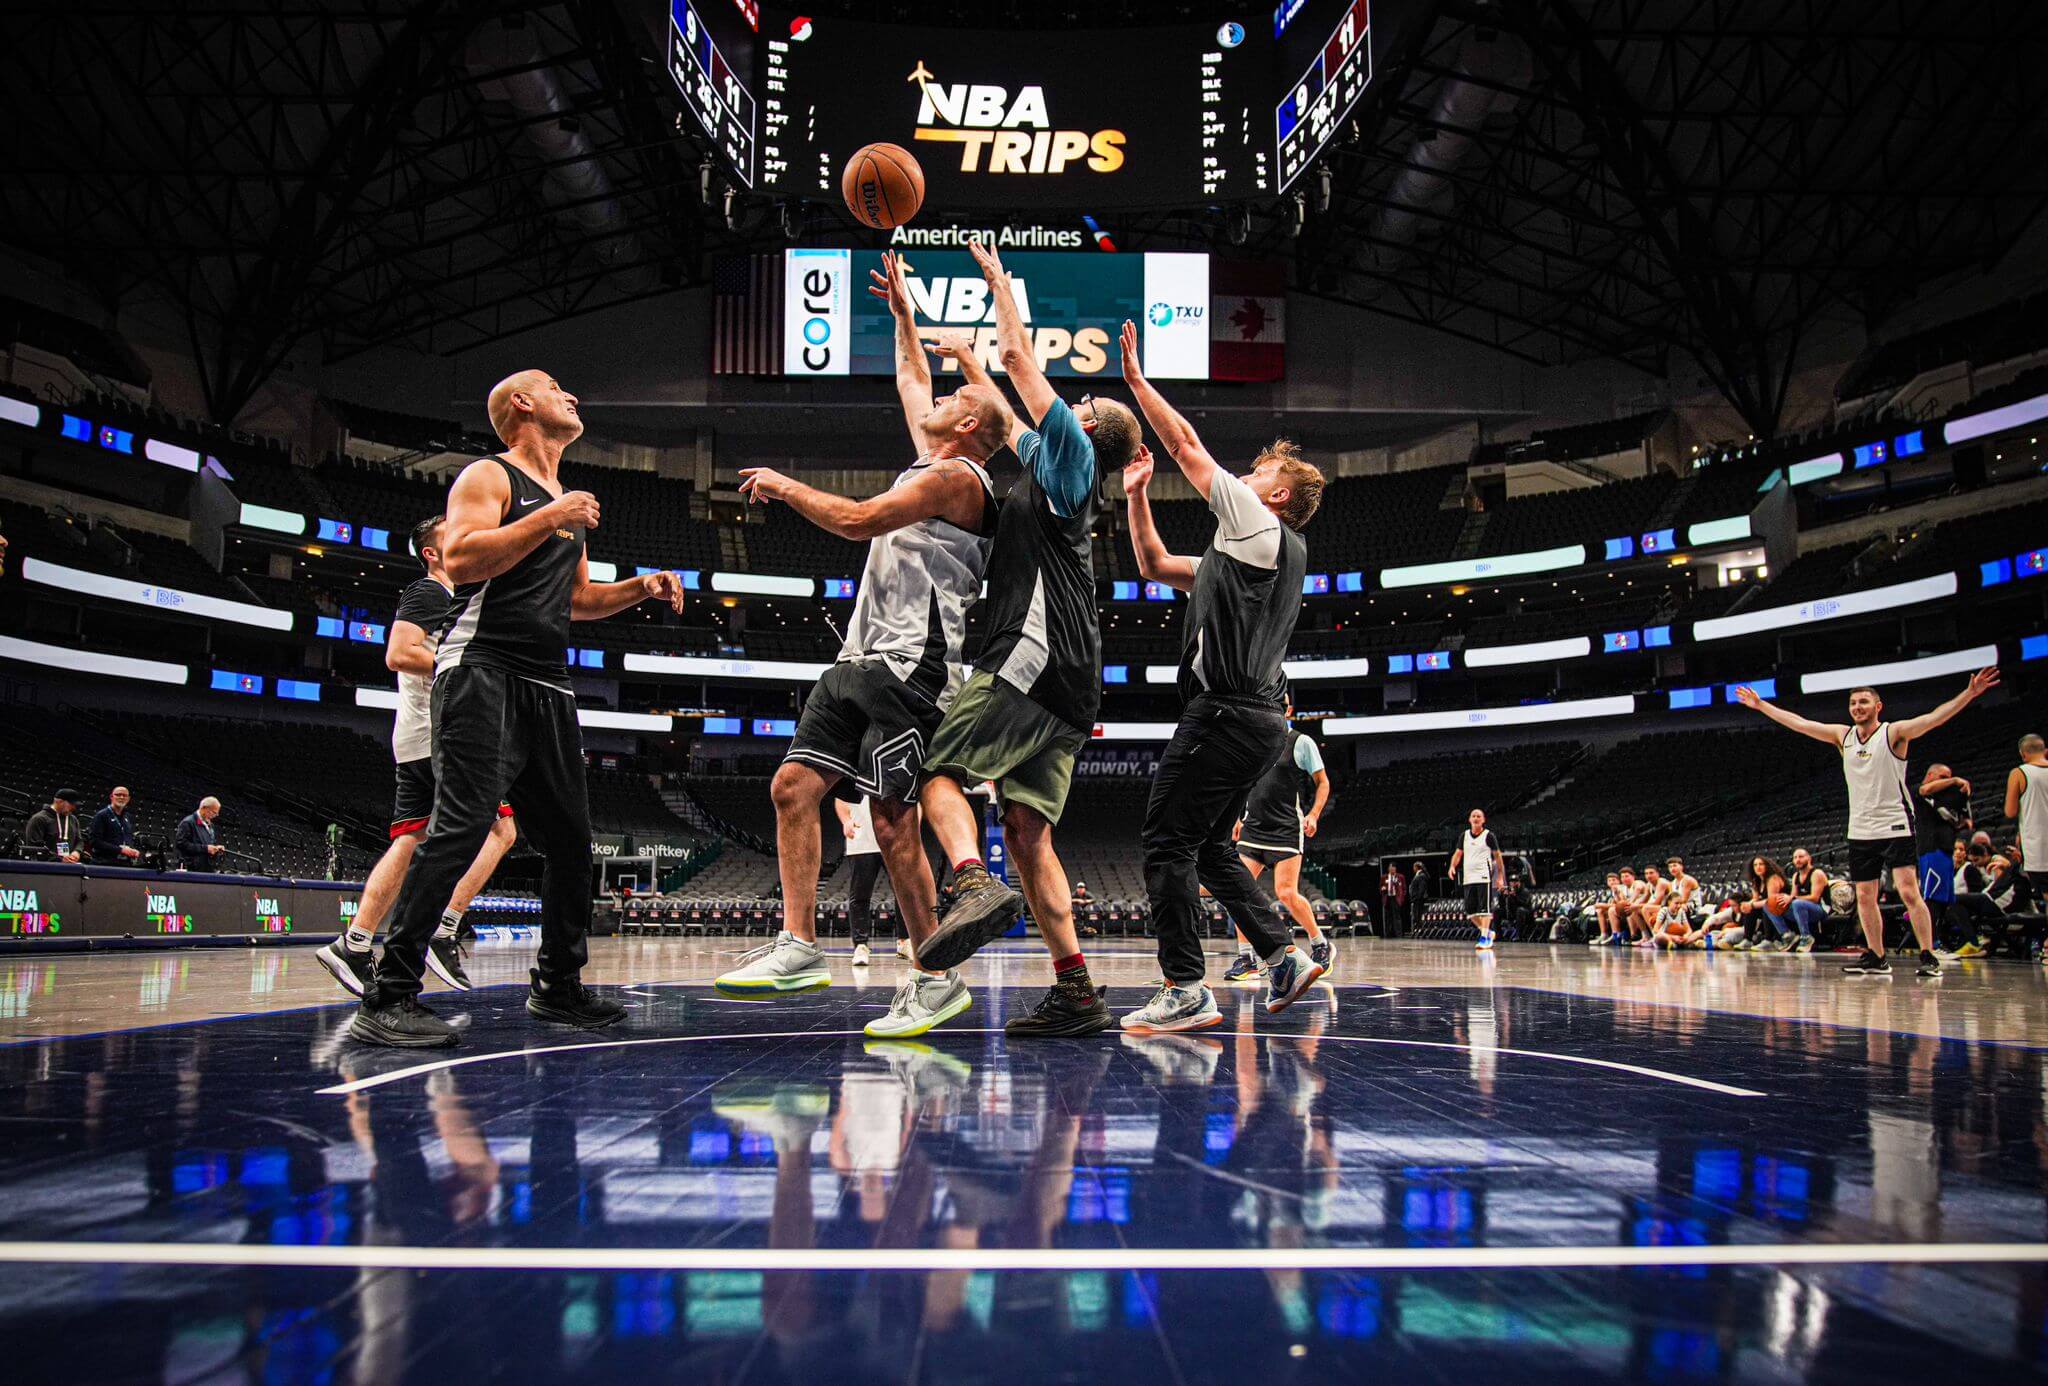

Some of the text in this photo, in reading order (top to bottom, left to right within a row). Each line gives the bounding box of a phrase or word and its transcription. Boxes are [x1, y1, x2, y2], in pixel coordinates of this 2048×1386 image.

[687, 10, 696, 44] 9
[1339, 13, 1354, 55] 11
[768, 54, 782, 64] TO
[1201, 67, 1216, 76] TO
[724, 75, 740, 114] 11
[767, 80, 786, 92] STL
[917, 82, 1050, 128] NBA
[1202, 92, 1221, 102] STL
[1296, 83, 1308, 117] 9
[914, 128, 1127, 174] TRIPS
[890, 224, 1083, 247] American Airlines
[803, 269, 831, 371] core
[1175, 306, 1204, 318] TXU
[917, 326, 1110, 374] TRPS
[1077, 761, 1142, 777] ROWDY,
[591, 842, 620, 859] tkey
[638, 844, 690, 860] shiftkey
[0, 889, 39, 911] NBA
[147, 895, 177, 914] NBA
[256, 899, 279, 915] NBA
[0, 913, 61, 934] TRIPS
[147, 914, 193, 933] TRIPS
[256, 916, 292, 932] TRIPS
